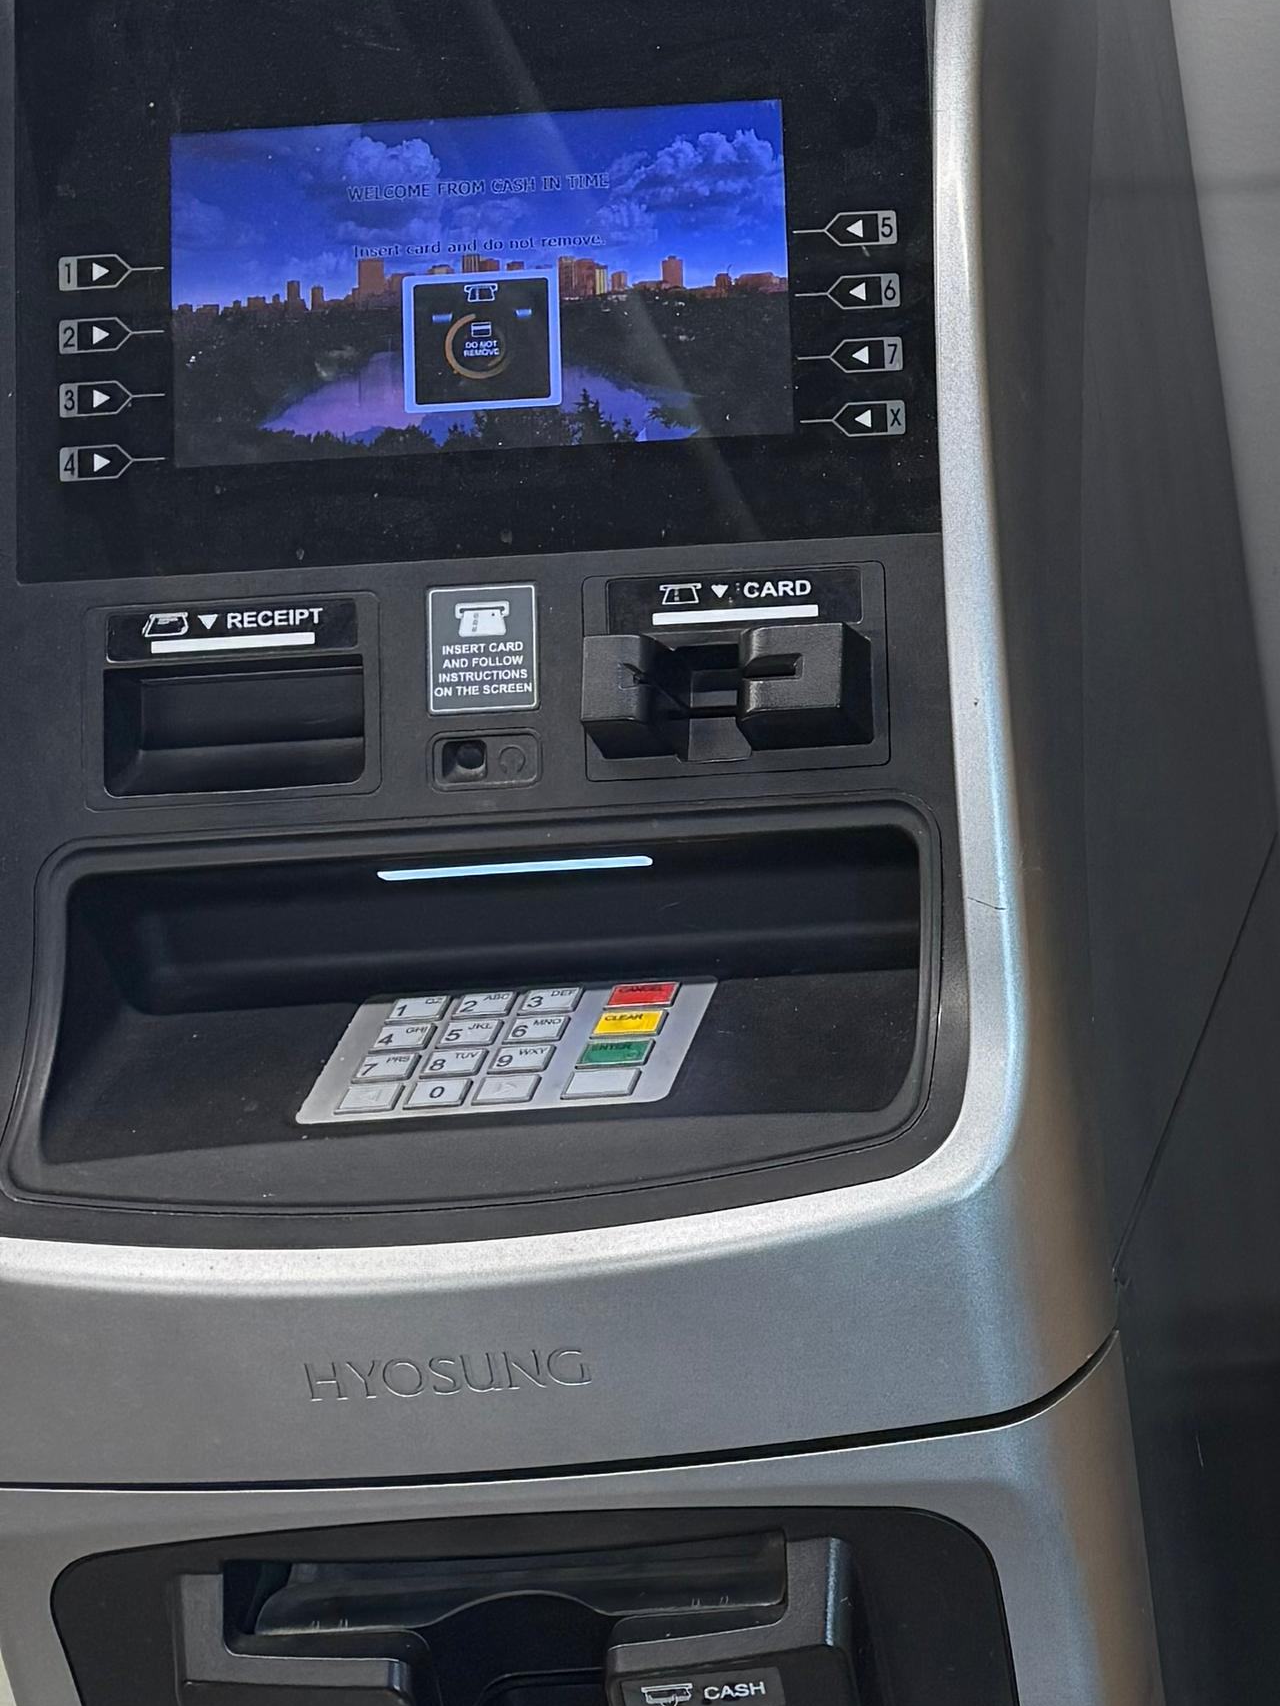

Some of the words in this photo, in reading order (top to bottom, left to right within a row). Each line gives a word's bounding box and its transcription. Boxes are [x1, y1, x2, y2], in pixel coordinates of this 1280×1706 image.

[348, 184, 430, 202] WELCOME
[438, 180, 484, 197] FROM
[491, 179, 535, 193] CASH
[542, 175, 561, 191] IN
[566, 173, 610, 188] TIME
[881, 217, 893, 237] 5
[354, 244, 400, 258] Insert
[407, 241, 440, 255] card
[448, 241, 477, 253] and
[484, 239, 502, 251] do
[510, 237, 534, 249] not
[541, 235, 606, 247] remove.
[64, 263, 72, 284] 1
[884, 280, 896, 301] 6
[63, 326, 75, 348] 2
[887, 344, 898, 365] 7
[63, 389, 75, 411] 3
[890, 409, 901, 426] X
[63, 453, 76, 476] 4
[742, 578, 812, 602] CARD
[227, 606, 323, 630] RECEIPT
[442, 644, 486, 655] INSERT
[489, 641, 524, 652] CARD
[443, 658, 468, 669] AND
[472, 655, 524, 667] FOLLOW
[439, 669, 528, 683] INSTRUCTIONS
[434, 687, 452, 697] ON
[456, 686, 479, 696] THE
[483, 683, 532, 694] SCREEN
[305, 1346, 595, 1403] HYOSUNG
[702, 1679, 766, 1702] CASH
